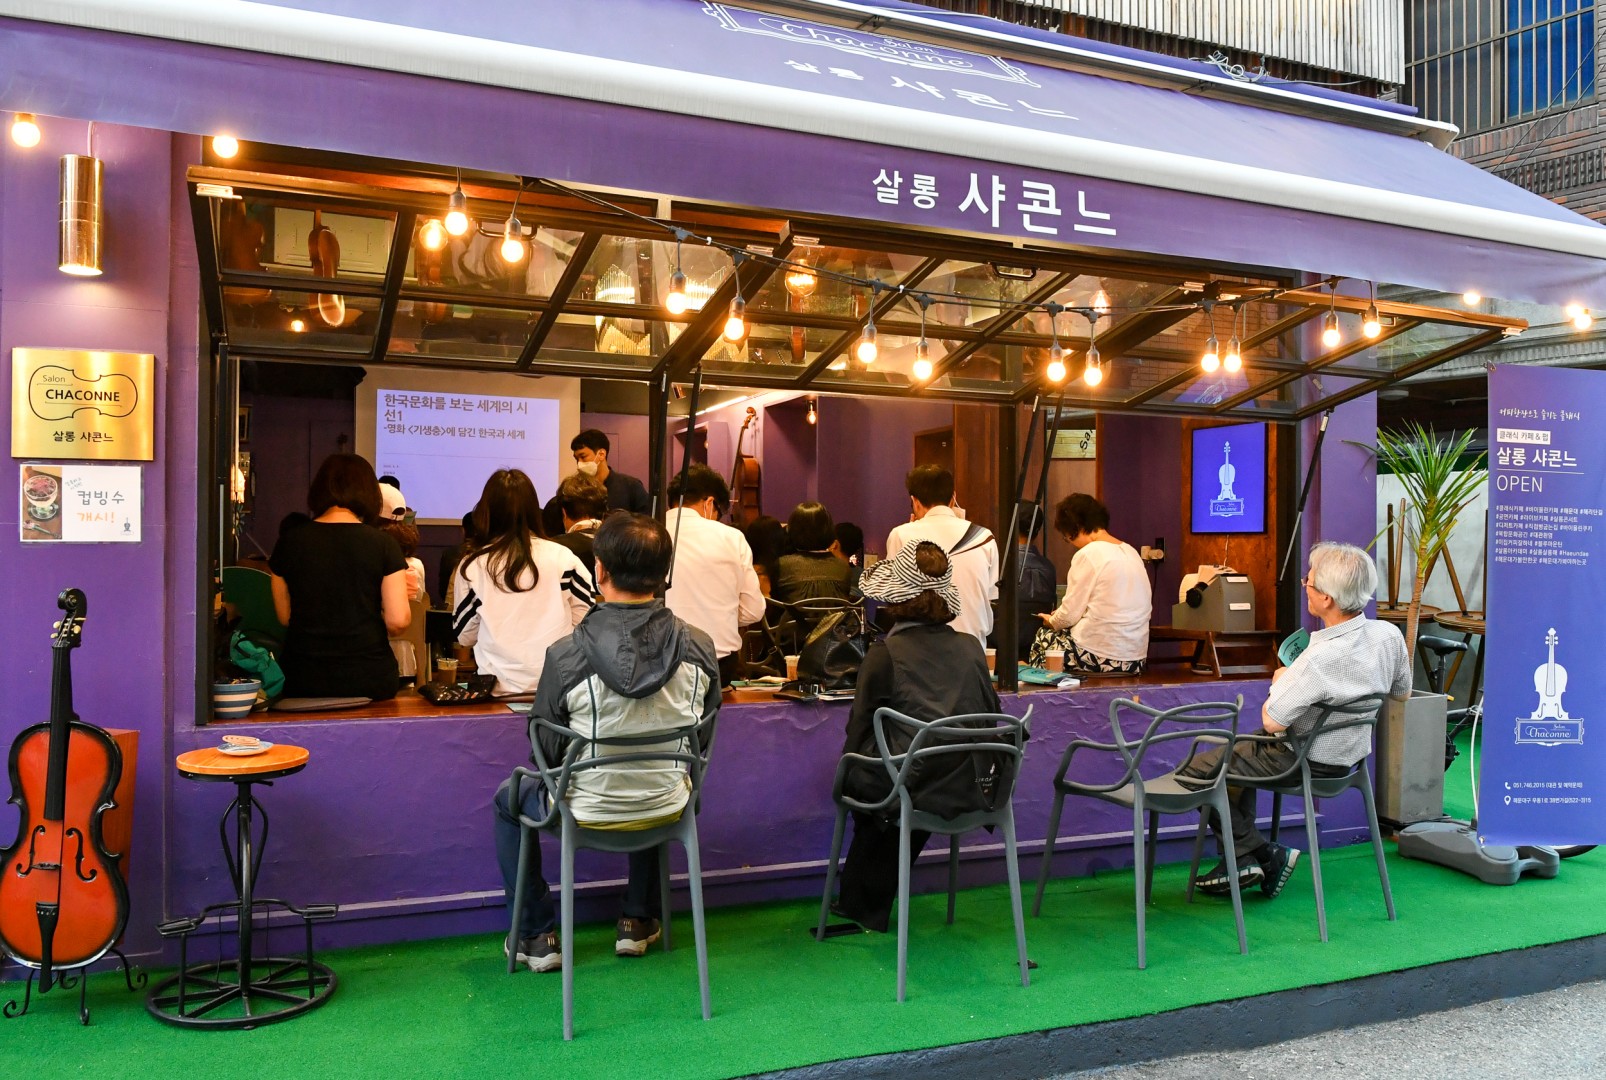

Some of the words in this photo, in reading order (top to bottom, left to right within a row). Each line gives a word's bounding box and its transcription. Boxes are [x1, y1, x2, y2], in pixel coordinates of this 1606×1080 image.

[758, 17, 974, 68] Chaconne
[883, 38, 940, 55] Salon
[783, 59, 864, 81] 살롱
[890, 75, 1080, 120] 샤콘느
[871, 168, 940, 210] 살롱
[957, 171, 1117, 237] 샤콘느
[42, 374, 66, 384] Salon
[45, 388, 120, 402] CHACONNE
[384, 393, 446, 411] 한국문화를
[449, 397, 475, 413] 보는
[477, 398, 513, 414] 세계의
[516, 401, 529, 415] 시
[384, 408, 404, 423] 선1
[52, 430, 76, 443] 살롱
[80, 431, 115, 443] 샤콘느
[383, 423, 406, 435] -영화
[408, 424, 456, 438] <기생충>에
[458, 427, 476, 439] 담긴
[479, 427, 506, 440] 한국과
[507, 429, 526, 441] 세계
[1499, 430, 1519, 441] 클래식
[1521, 431, 1534, 442] 카페
[1535, 432, 1542, 441] &
[1496, 446, 1527, 467] 살롱
[1532, 448, 1578, 468] 샤콘느
[1496, 474, 1543, 493] OPEN
[76, 490, 126, 506] 컵빙수
[76, 511, 115, 524] 개시!
[1559, 550, 1590, 558] #Haeundae
[1525, 725, 1572, 739] Chaconne
